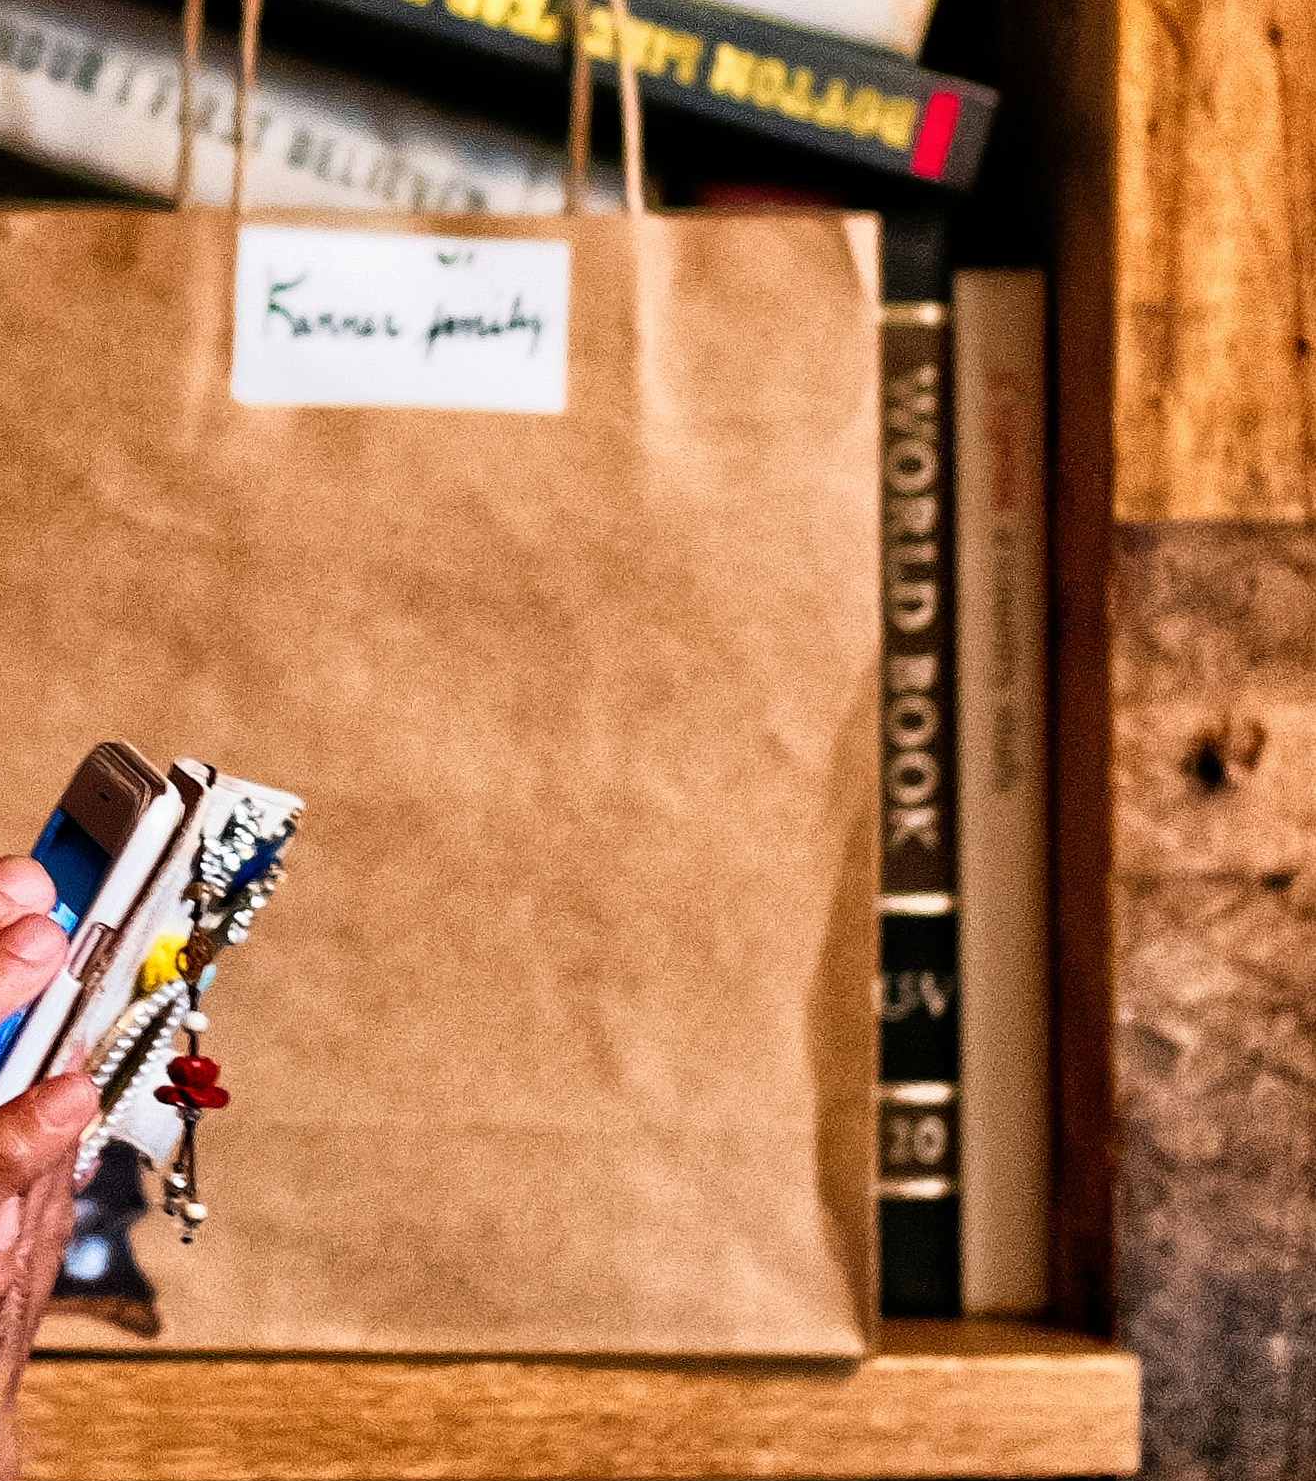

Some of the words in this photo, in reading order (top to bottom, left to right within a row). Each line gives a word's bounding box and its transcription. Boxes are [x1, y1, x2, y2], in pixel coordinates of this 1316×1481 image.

[710, 63, 924, 153] BOTTOM
[886, 362, 941, 635] WORLD
[886, 664, 941, 849] BOOK
